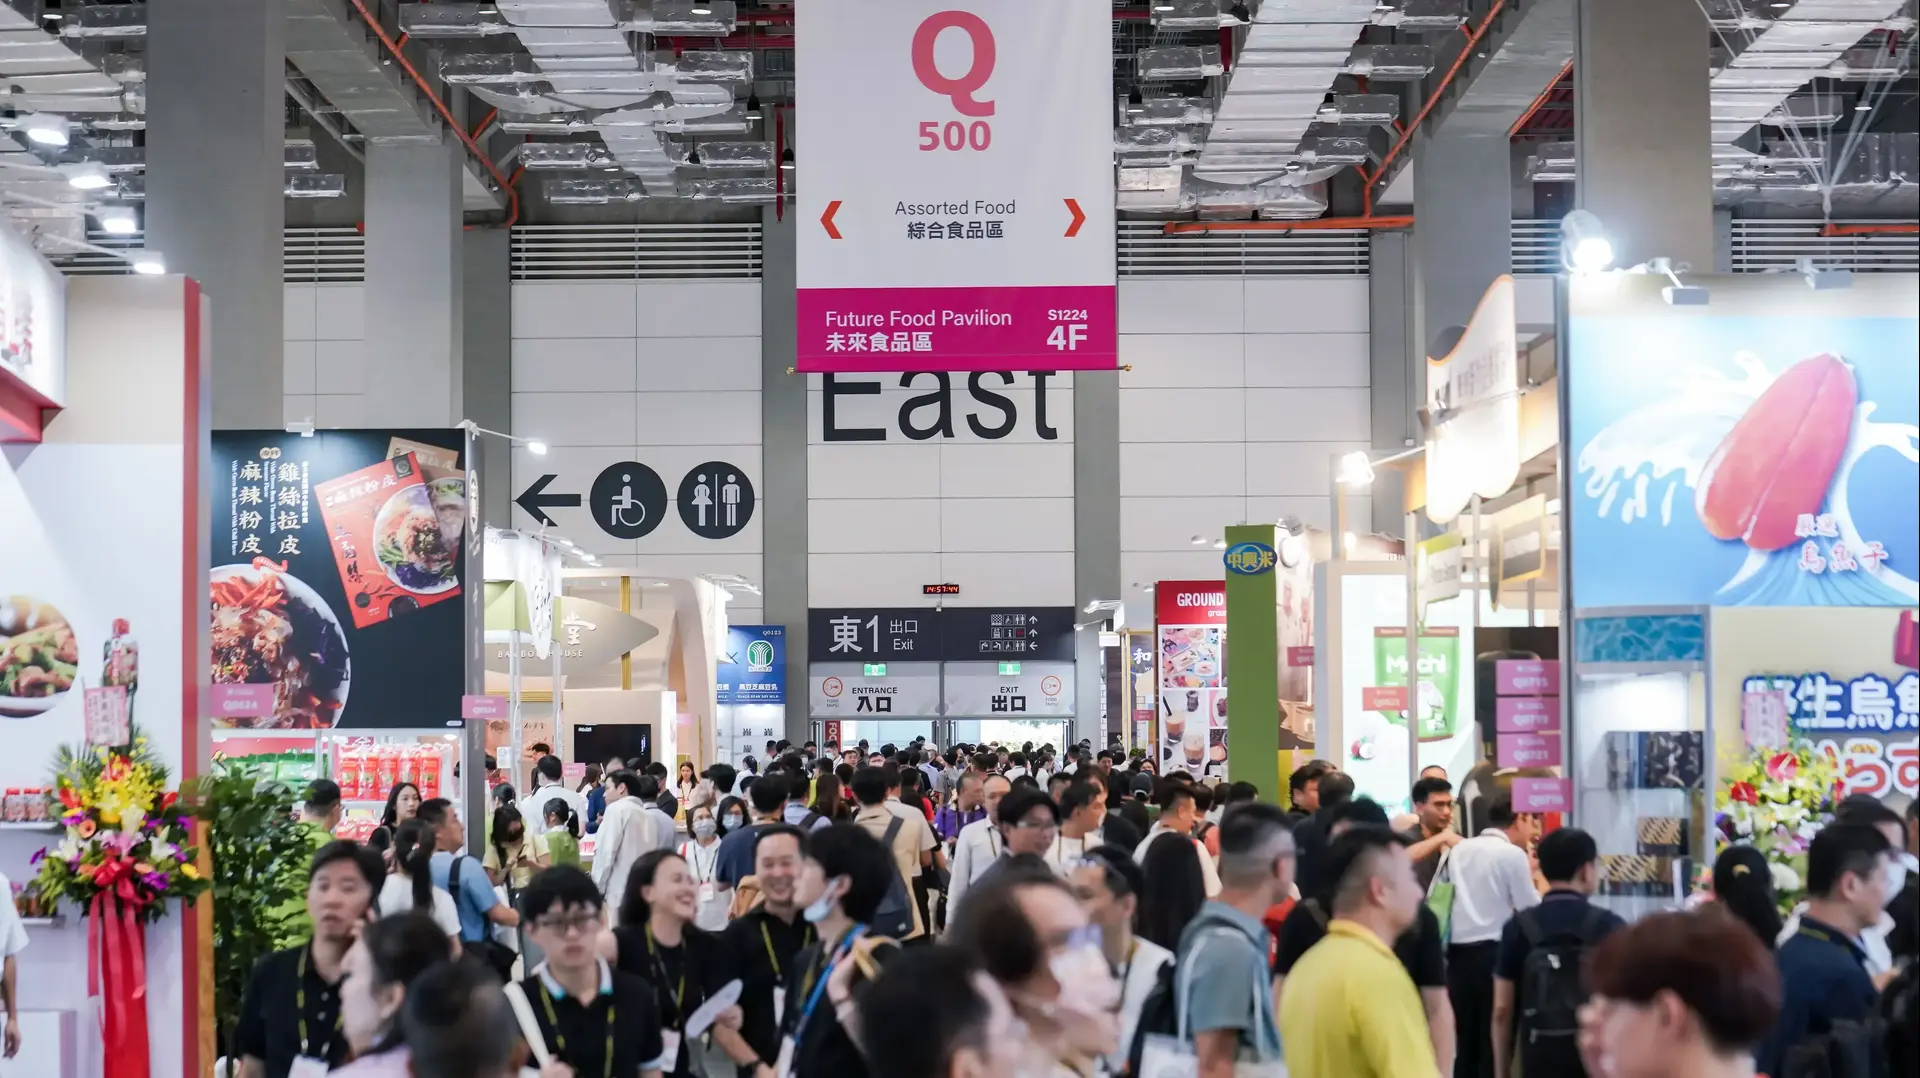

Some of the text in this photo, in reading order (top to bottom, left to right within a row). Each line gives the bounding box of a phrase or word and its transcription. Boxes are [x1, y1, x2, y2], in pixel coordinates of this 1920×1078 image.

[911, 10, 996, 117] Q
[919, 121, 991, 151] 500
[895, 199, 1016, 215] Assorted Food
[907, 221, 1004, 239] 綜合食品區
[825, 309, 1012, 327] Future Food Pavilion
[1047, 309, 1088, 321] S1224
[825, 332, 933, 352] 未來食品區
[1046, 324, 1088, 351] 4F
[822, 370, 1058, 441] East
[239, 461, 263, 554] 麻辣粉皮
[277, 462, 301, 555] 雞絲拉皮
[1176, 592, 1224, 607] GROUND
[828, 615, 879, 653] 東1
[889, 619, 918, 634] 出口
[893, 638, 914, 651] Exit
[1133, 648, 1153, 665] 和
[856, 696, 892, 713] 入口
[991, 695, 1026, 712] 出口
